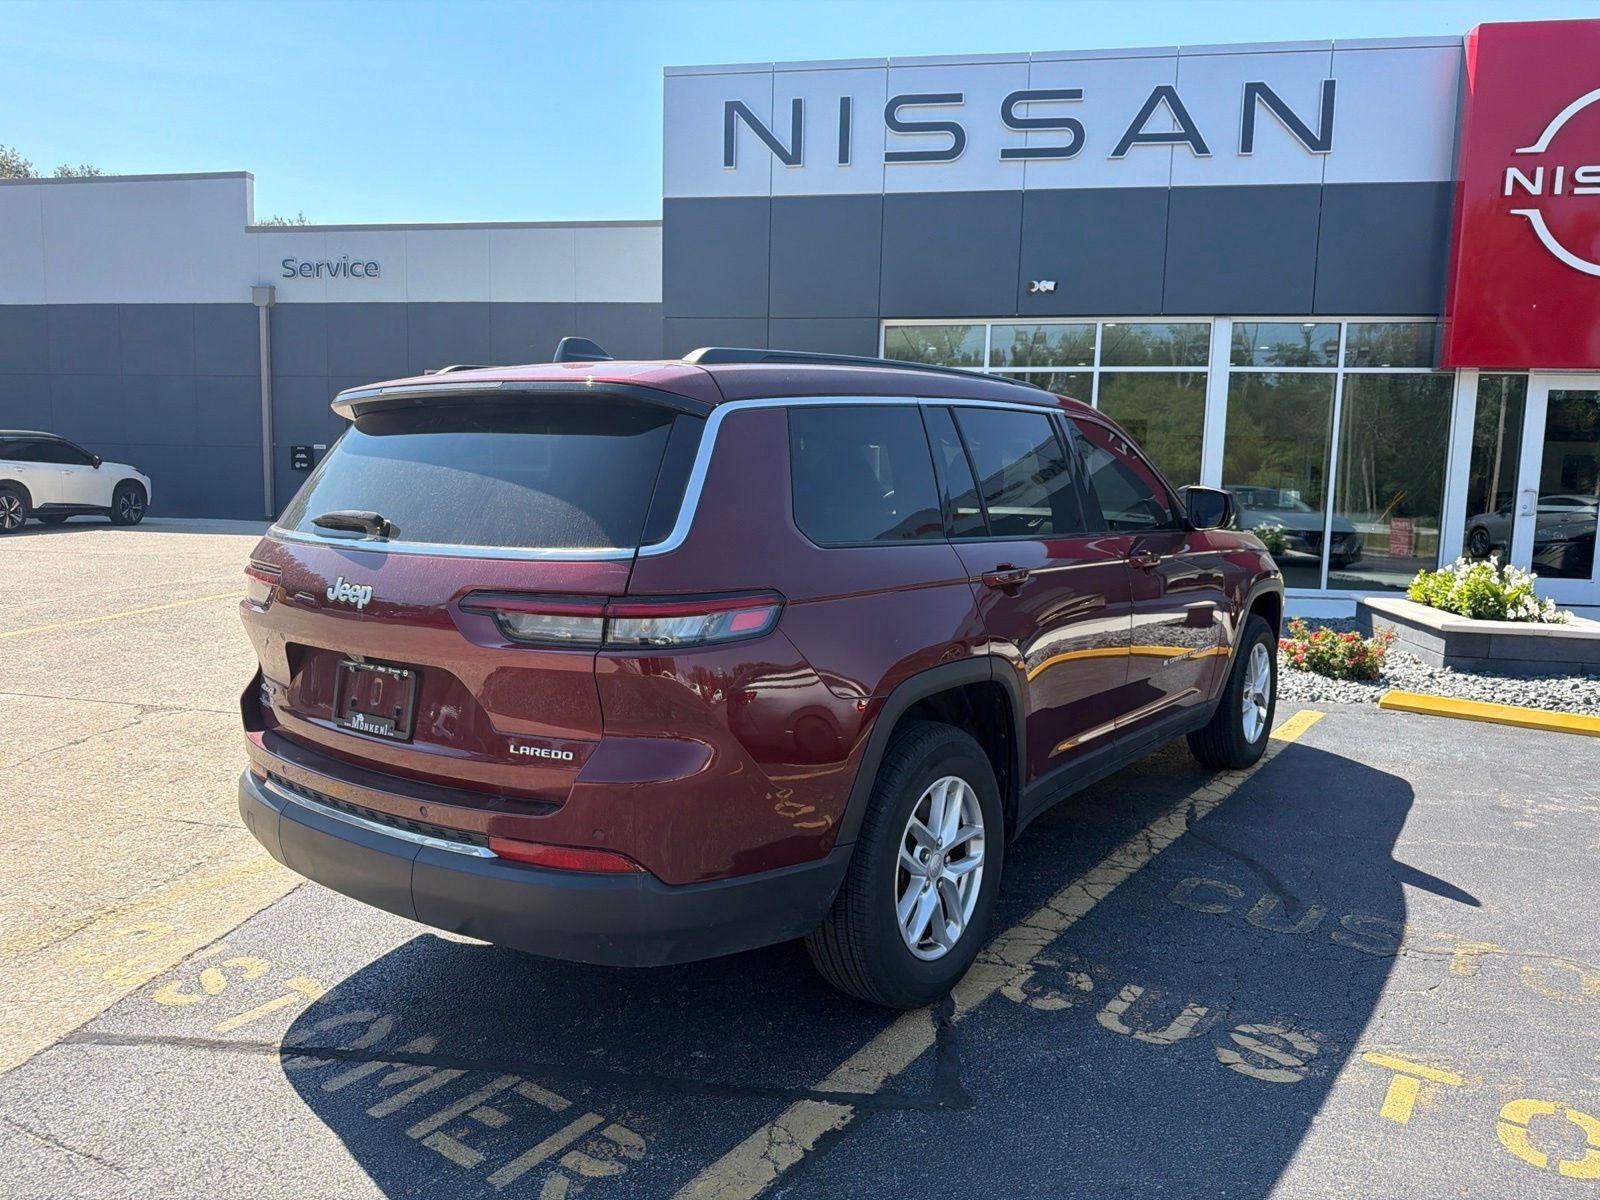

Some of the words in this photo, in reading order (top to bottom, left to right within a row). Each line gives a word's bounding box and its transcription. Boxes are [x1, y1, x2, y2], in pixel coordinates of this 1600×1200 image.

[722, 79, 1337, 169] NISSAN
[281, 256, 380, 278] Service
[326, 576, 373, 609] Jeep
[509, 744, 573, 761] LAREDO
